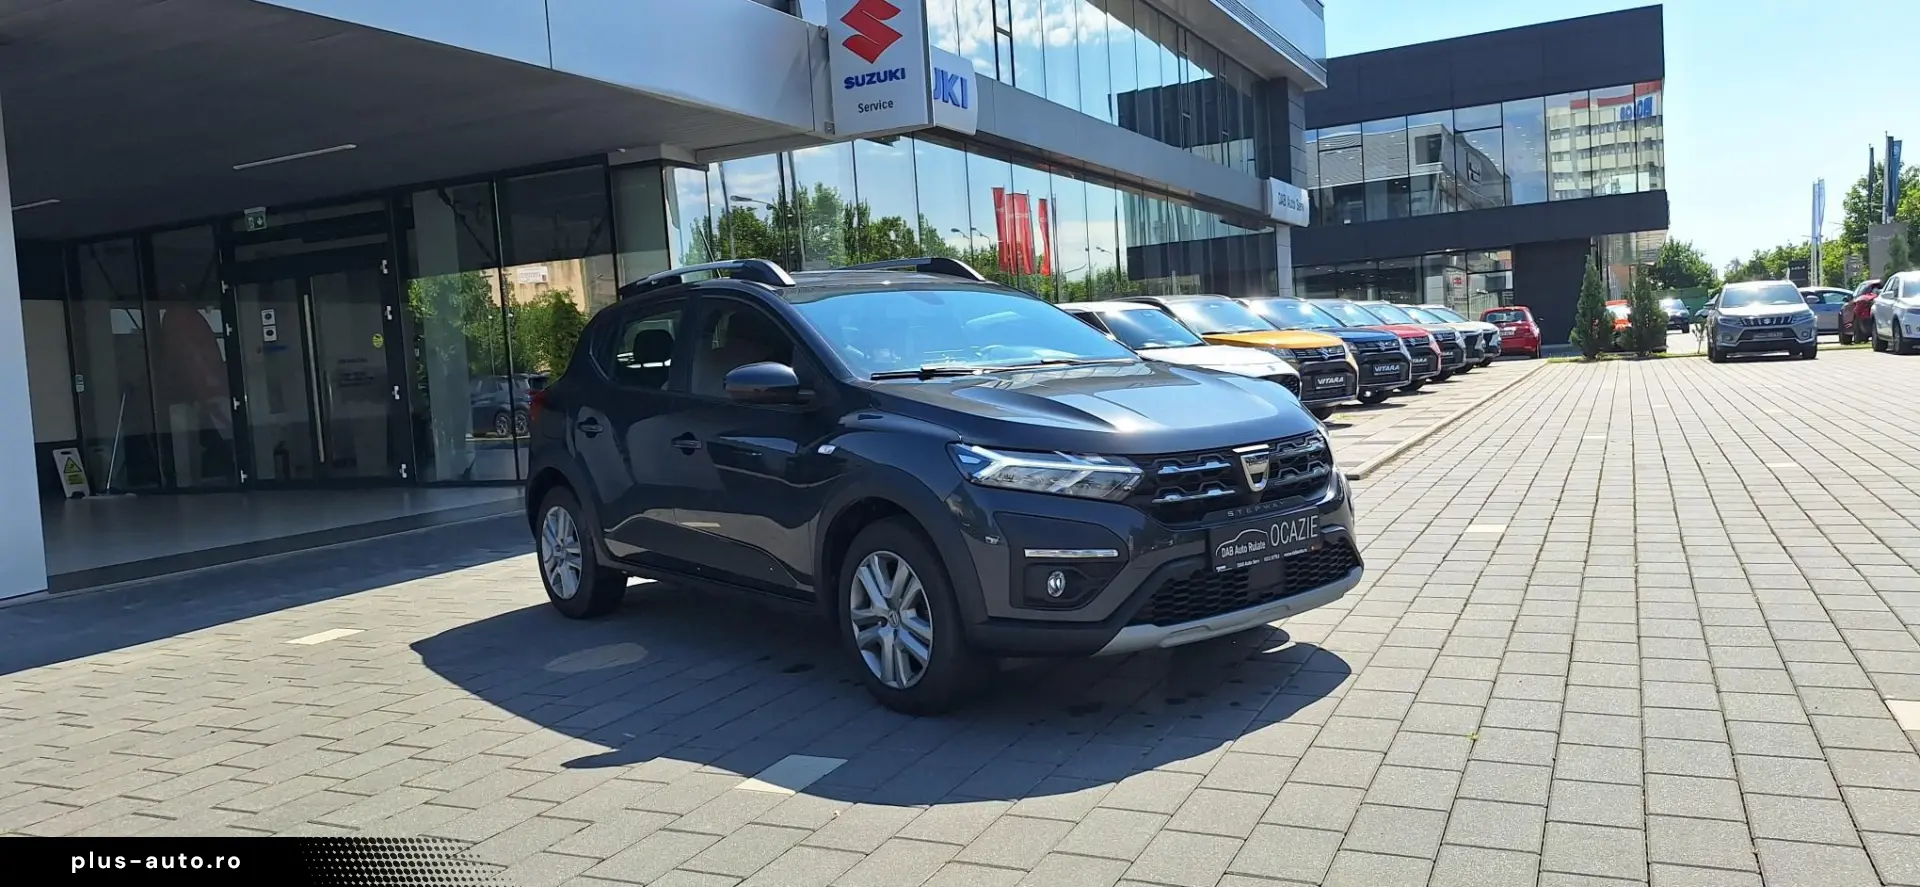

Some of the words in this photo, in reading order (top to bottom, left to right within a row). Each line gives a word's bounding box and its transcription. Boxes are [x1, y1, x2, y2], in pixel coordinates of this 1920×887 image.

[844, 67, 906, 90] SUZUKI
[858, 99, 894, 114] Service
[1374, 364, 1400, 372] VITARA
[1317, 376, 1344, 385] VITARA
[1227, 500, 1285, 517] STEPWAY
[1270, 515, 1318, 547] OCAZIE
[1221, 546, 1234, 558] DAB
[1234, 543, 1248, 556] Auto
